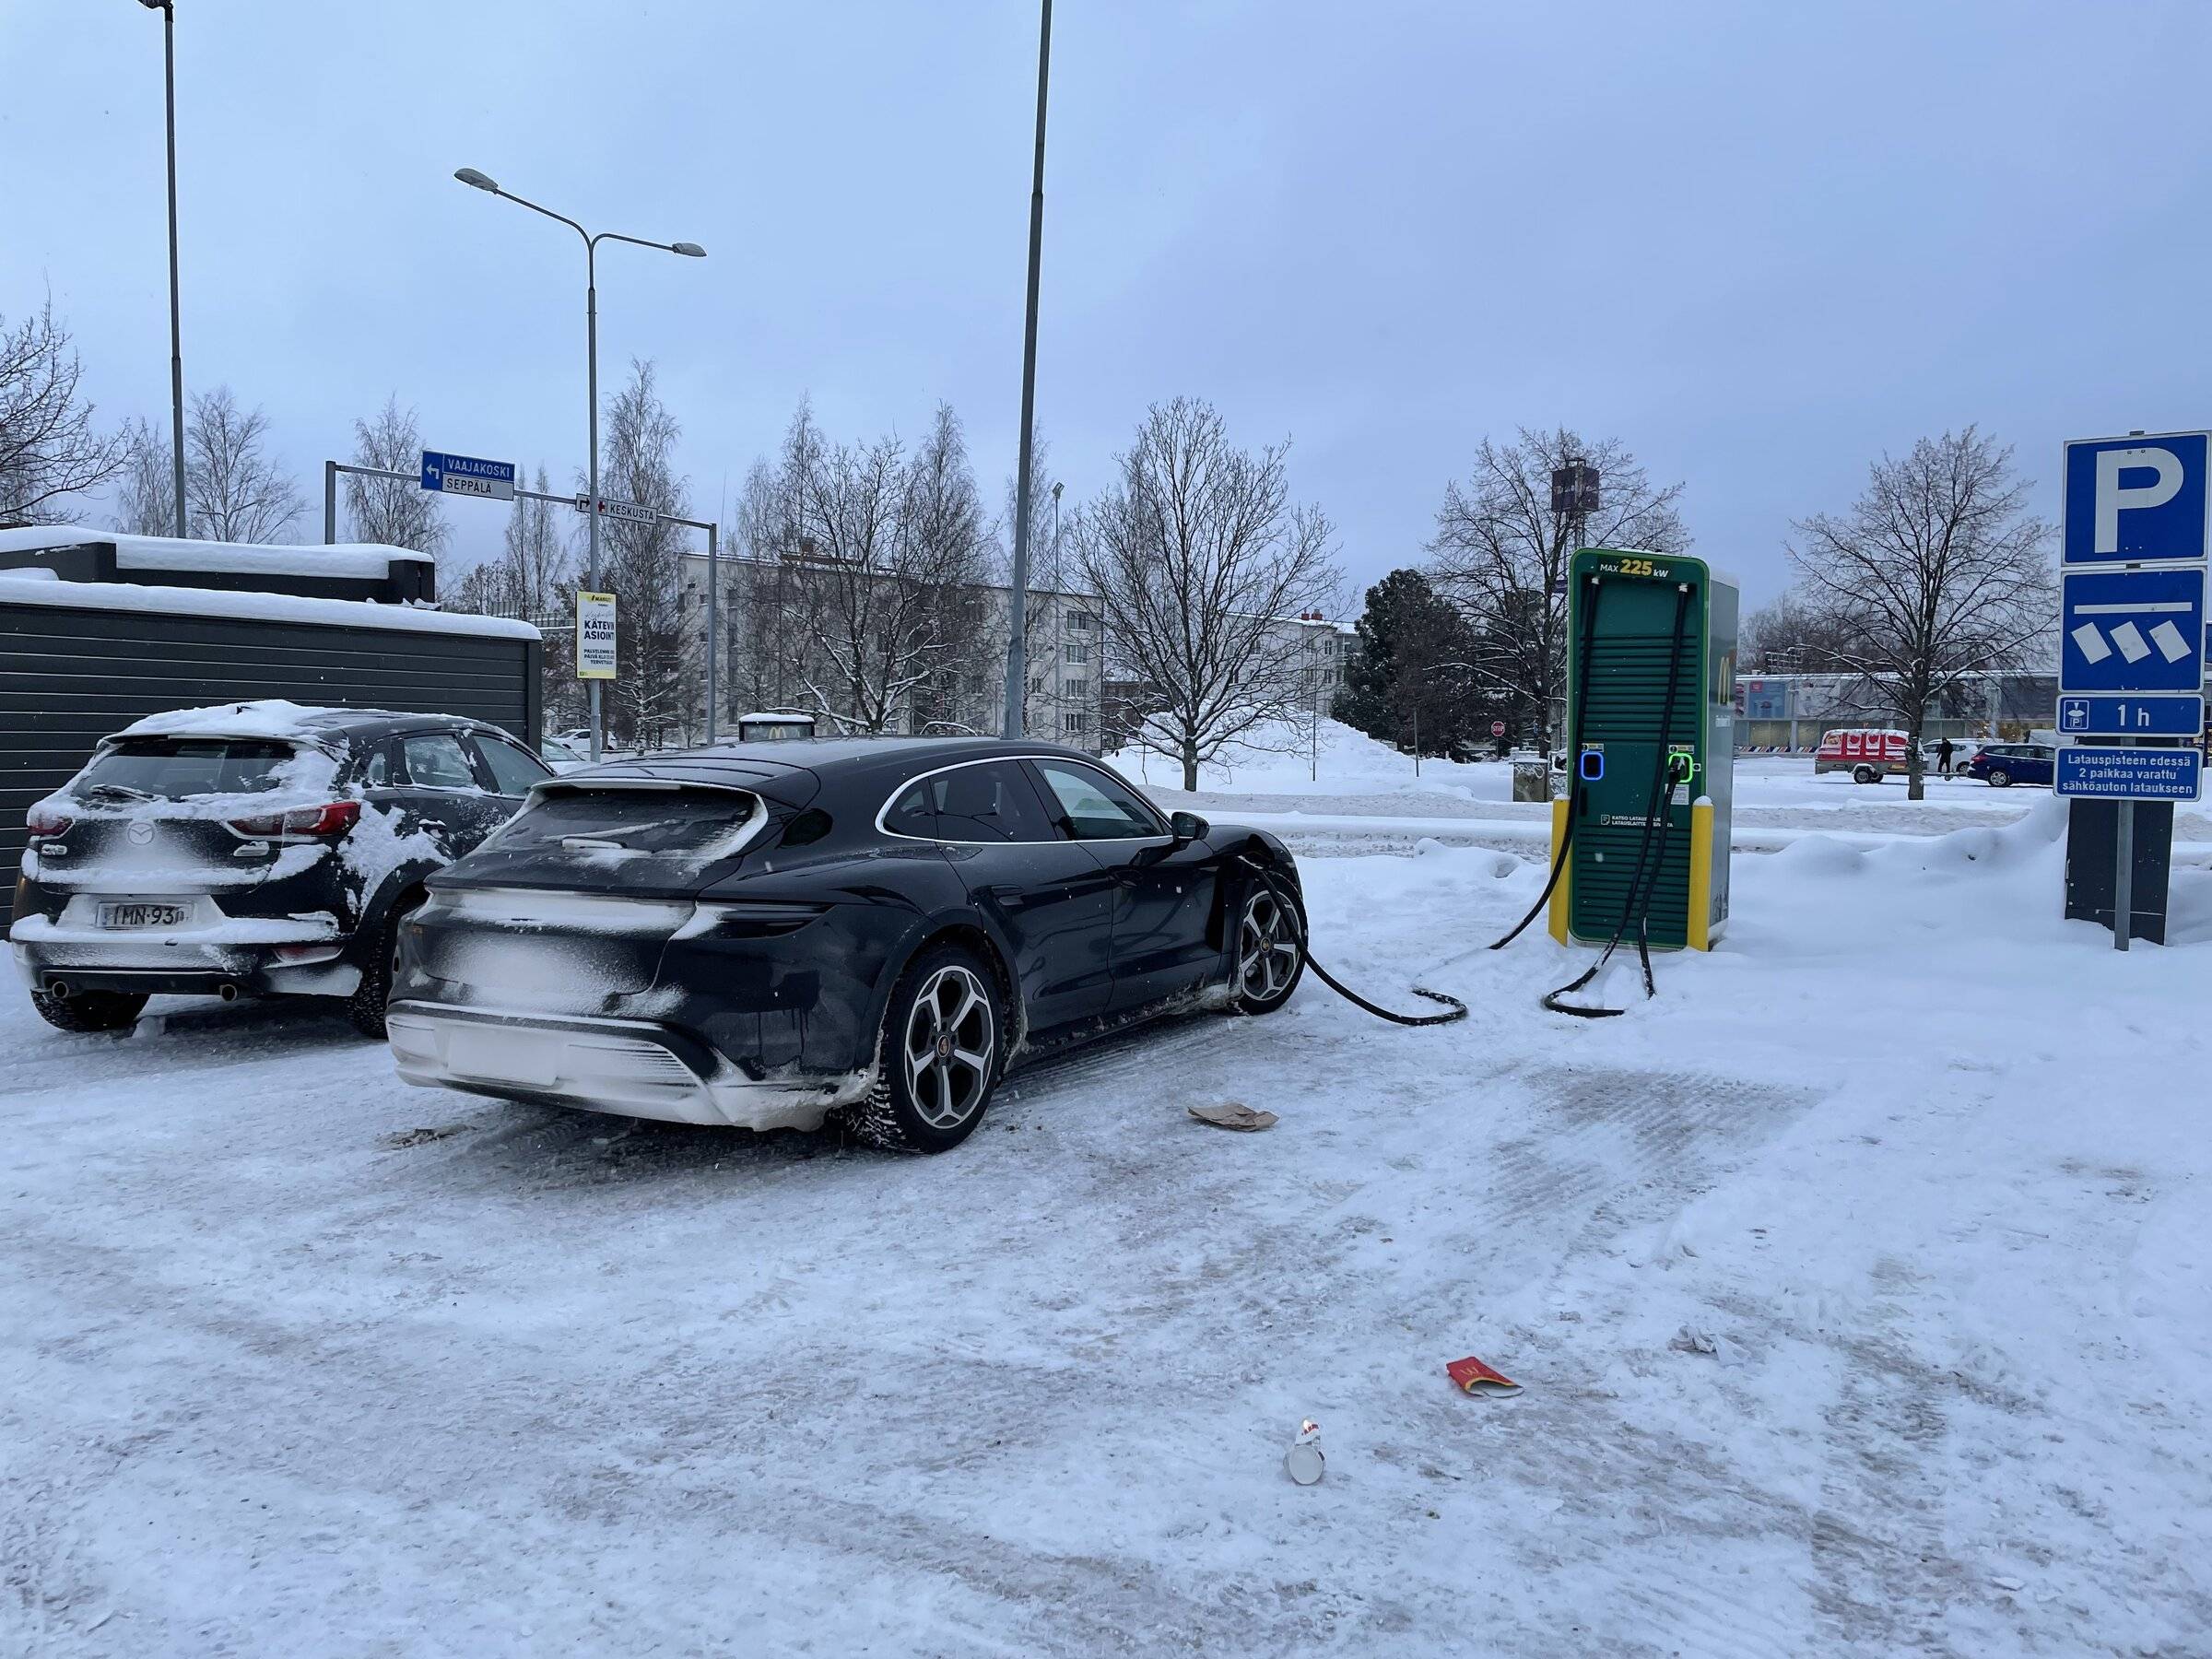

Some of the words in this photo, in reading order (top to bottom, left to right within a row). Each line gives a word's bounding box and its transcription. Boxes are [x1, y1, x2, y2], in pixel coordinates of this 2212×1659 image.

[447, 458, 510, 478] VAAJAKOSKI
[446, 478, 492, 494] SEPPÄLÄ
[2095, 447, 2184, 554] P
[609, 503, 653, 521] KESKUSTA
[1599, 563, 1619, 572] MAX
[1619, 559, 1653, 576] 225
[1653, 569, 1669, 578] kW
[2118, 704, 2126, 726] 1
[2137, 707, 2150, 726] h
[2067, 754, 2147, 767] Latauspisteen
[2149, 756, 2191, 767] edessä
[2078, 768, 2087, 778] 2
[2089, 769, 2134, 779] paikkaa
[2136, 771, 2177, 780] varattu
[2062, 781, 2127, 793] sähköauton
[2130, 782, 2193, 794] lataukseen
